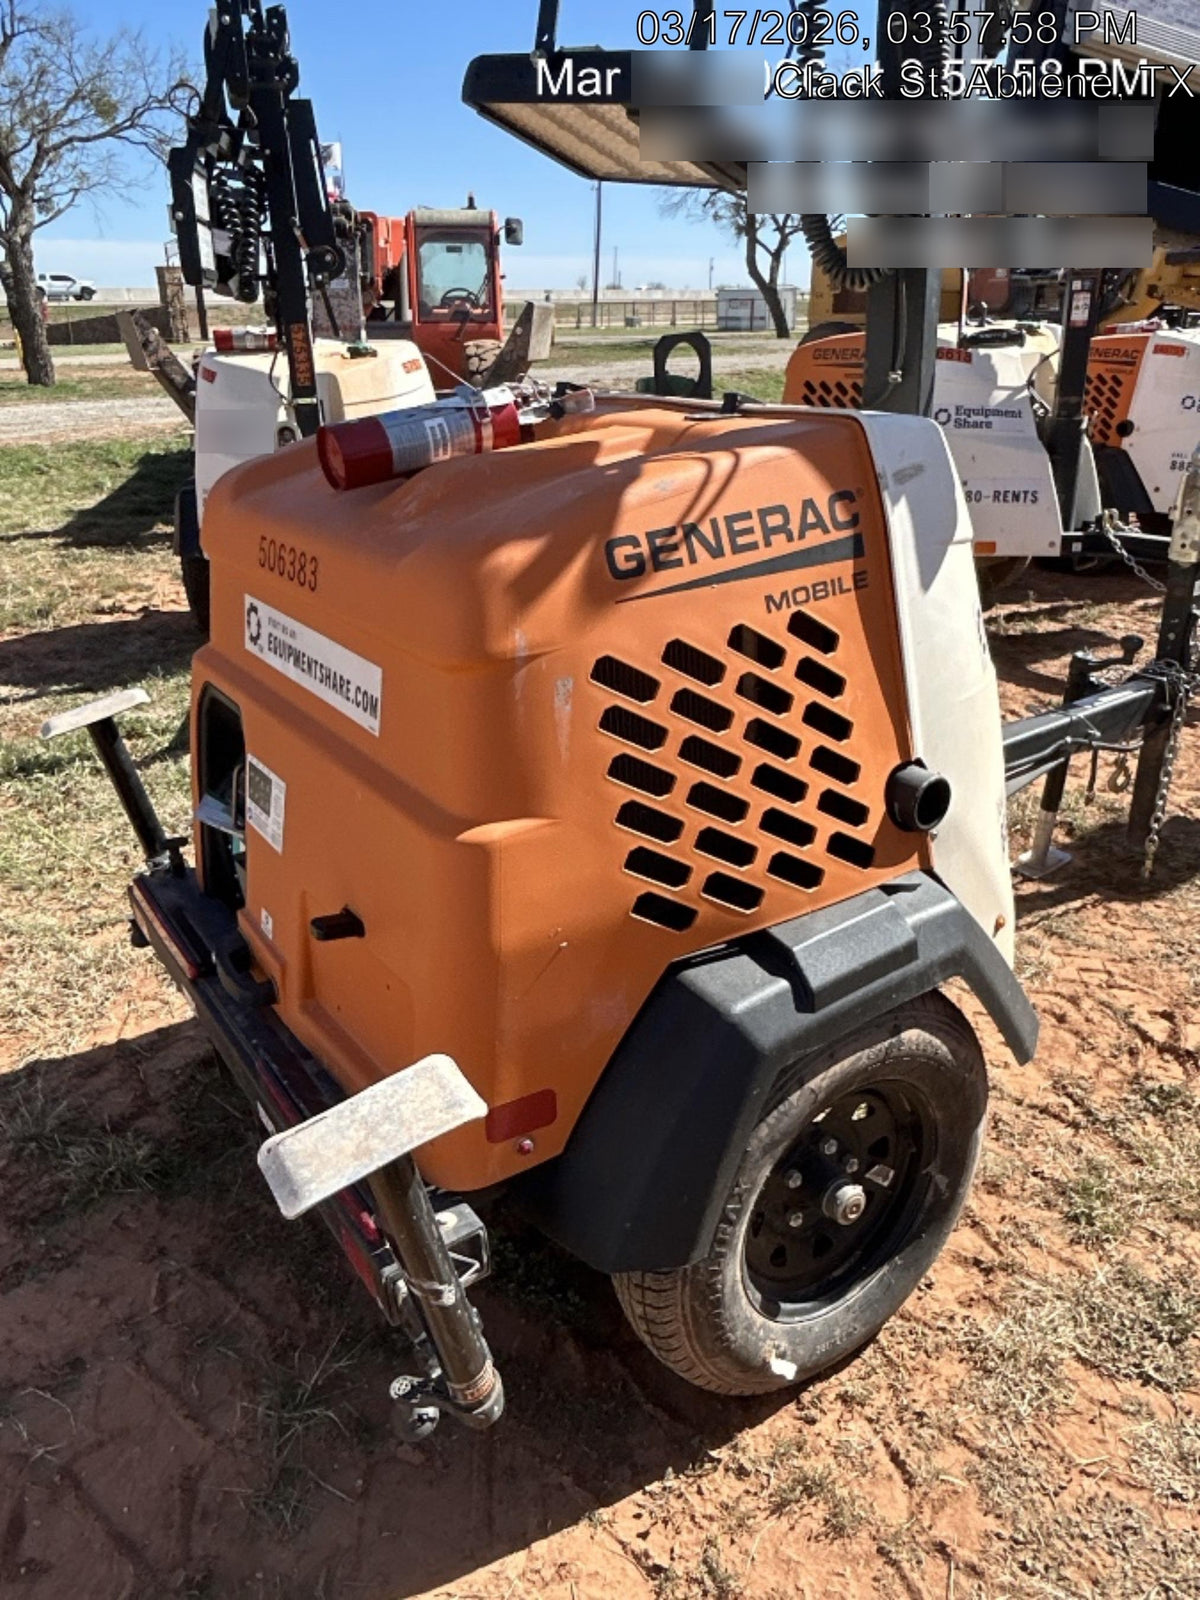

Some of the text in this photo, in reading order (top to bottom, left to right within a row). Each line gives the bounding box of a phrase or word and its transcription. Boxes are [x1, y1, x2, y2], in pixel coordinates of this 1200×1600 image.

[813, 347, 865, 361] GENER
[953, 418, 993, 429] Share
[954, 405, 1023, 419] Equipment
[604, 489, 862, 581] GENERAC
[259, 535, 319, 592] 506383
[764, 570, 869, 614] MOBILE
[267, 632, 379, 720] EQUIPMENTSHARE.COM
